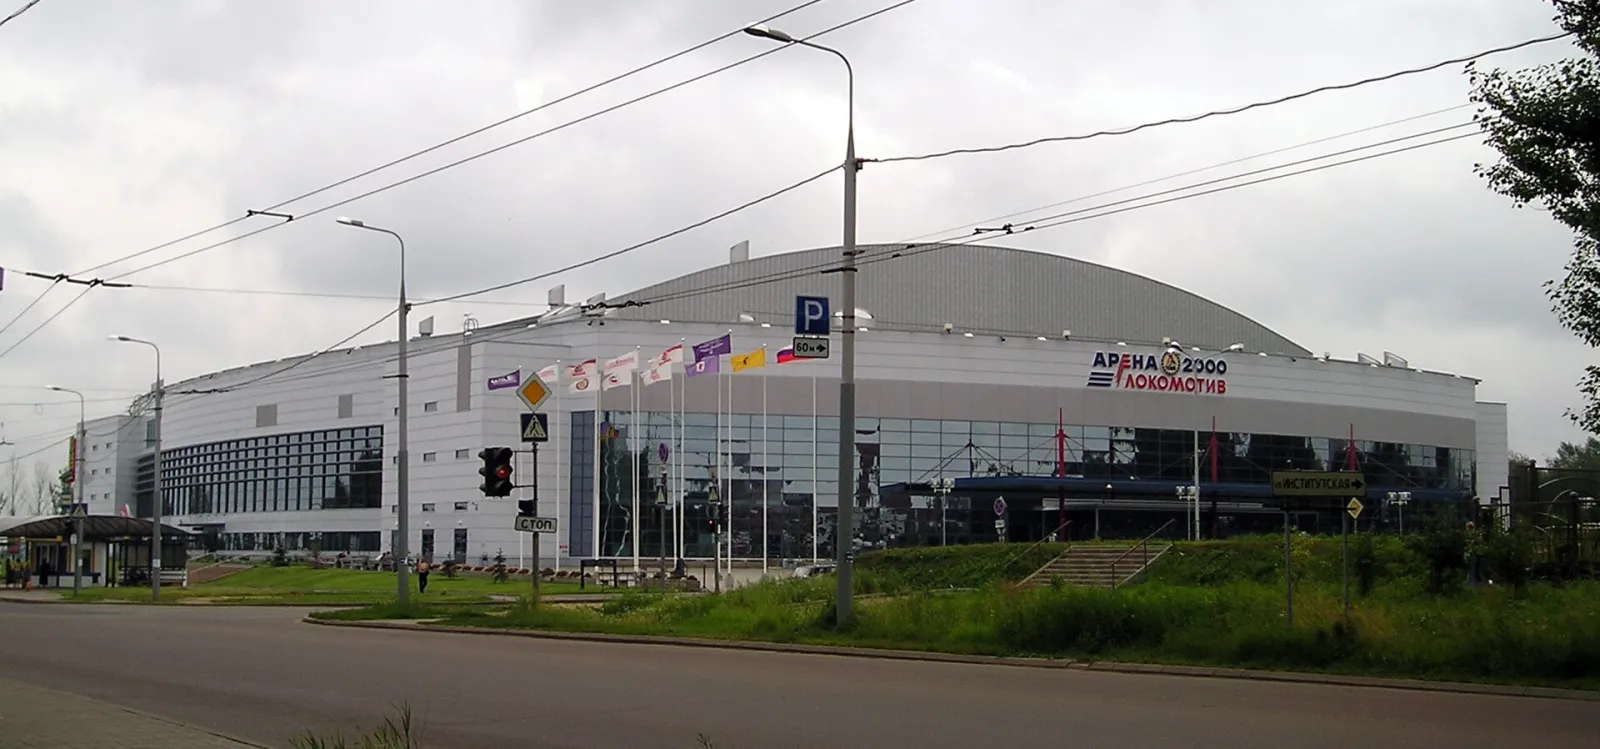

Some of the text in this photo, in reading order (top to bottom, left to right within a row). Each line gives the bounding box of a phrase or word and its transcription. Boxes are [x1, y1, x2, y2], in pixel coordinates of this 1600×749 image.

[805, 299, 823, 330] P
[1093, 352, 1227, 377] АРЕНА 2000
[1124, 374, 1227, 394] ЛОКОМОТИВ
[1282, 478, 1350, 489] ИНСТИТУТСКАЯ
[521, 519, 551, 530] СТОП
